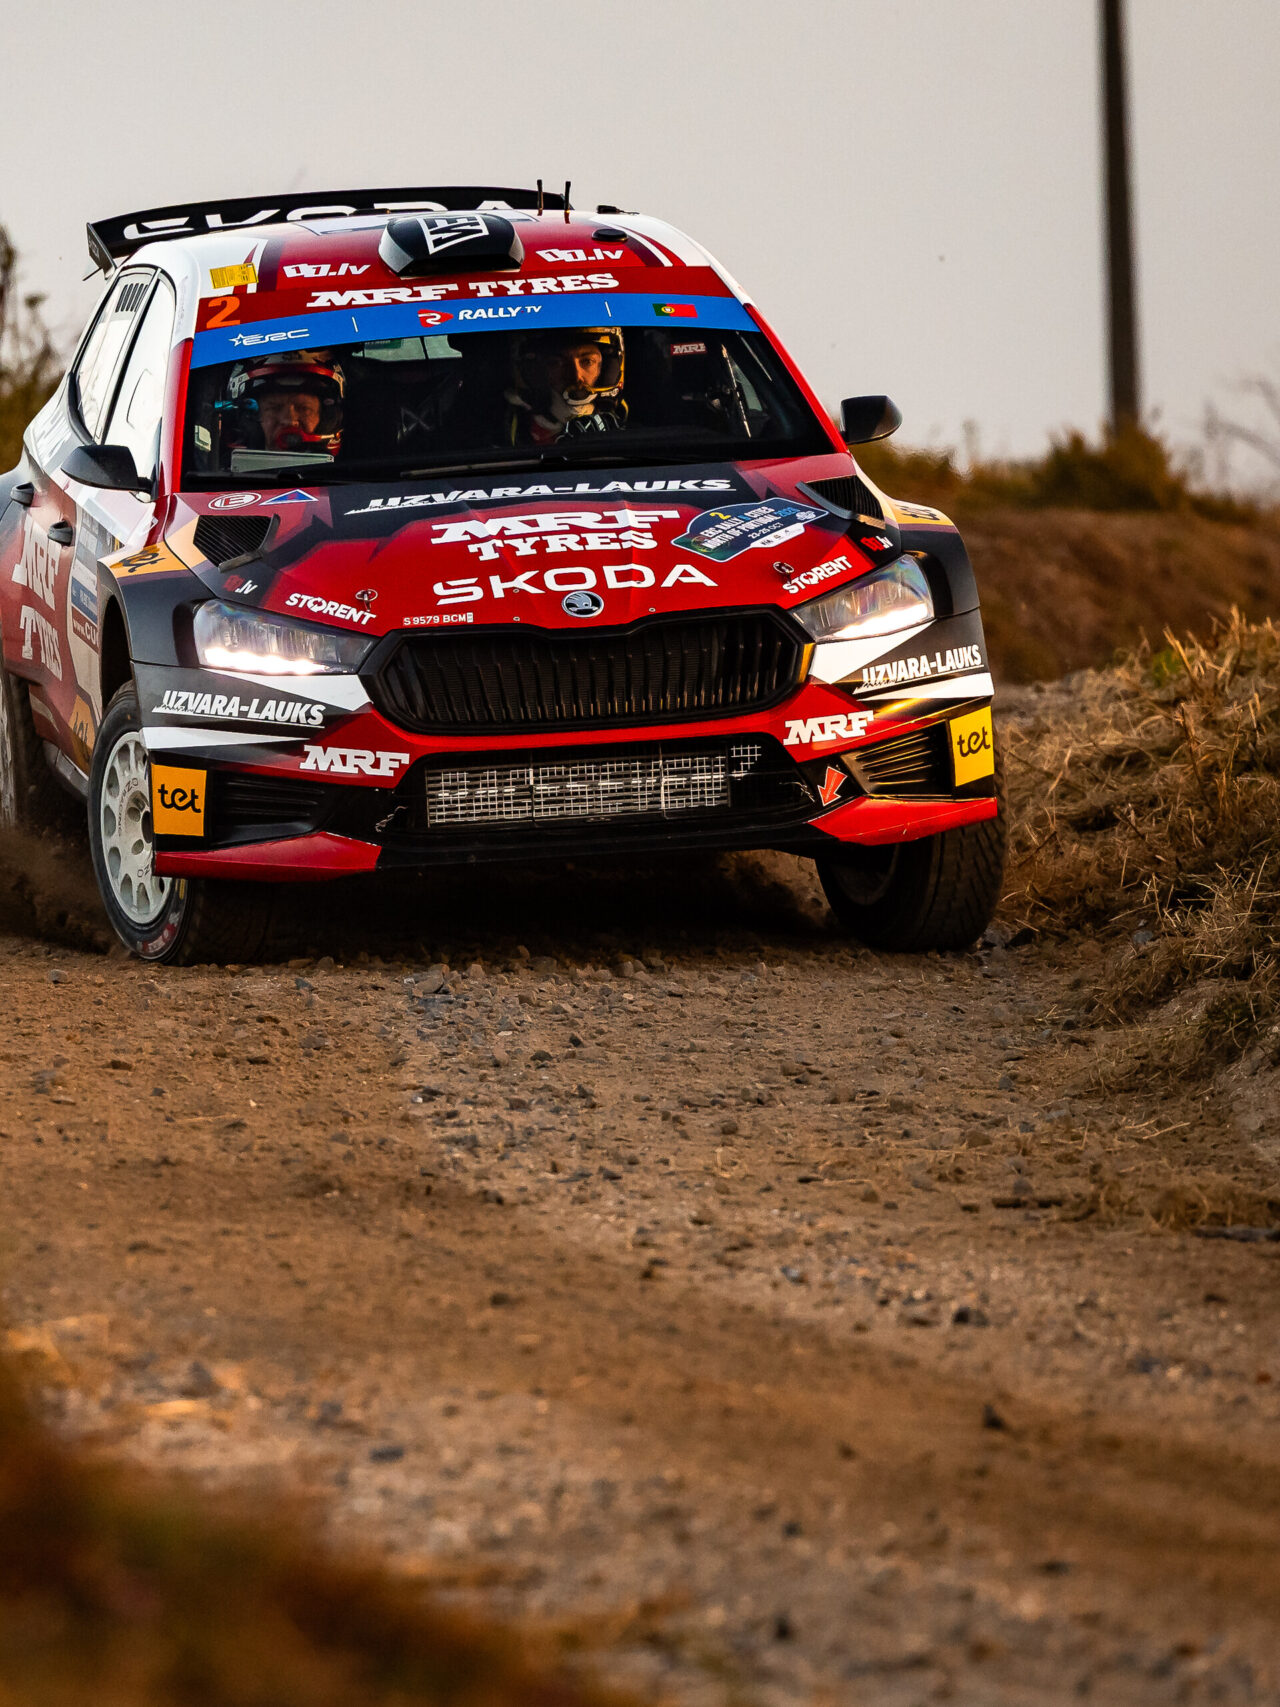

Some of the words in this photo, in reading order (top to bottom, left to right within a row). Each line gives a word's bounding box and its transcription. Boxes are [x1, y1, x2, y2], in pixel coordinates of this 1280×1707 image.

[306, 284, 459, 308] MRF
[468, 273, 620, 298] TYRES
[206, 296, 241, 329] 2
[458, 306, 522, 321] RALLY
[241, 328, 310, 346] ERC
[366, 479, 732, 511] UZVARA-LAUKS
[430, 508, 681, 545] MRF
[709, 511, 731, 520] 2
[12, 513, 62, 612] MRF
[467, 531, 658, 561] TYRES
[782, 555, 853, 594] STORENT
[285, 592, 376, 627] STORENT
[412, 614, 440, 625] 9579
[442, 612, 466, 623] BCM
[858, 644, 983, 688] UZVARA-LAUKS
[158, 690, 326, 727] UZVARA-LAUKS
[783, 710, 874, 746] MRF
[956, 726, 991, 758] tet
[299, 744, 410, 777] MRF
[157, 783, 202, 814] tet
